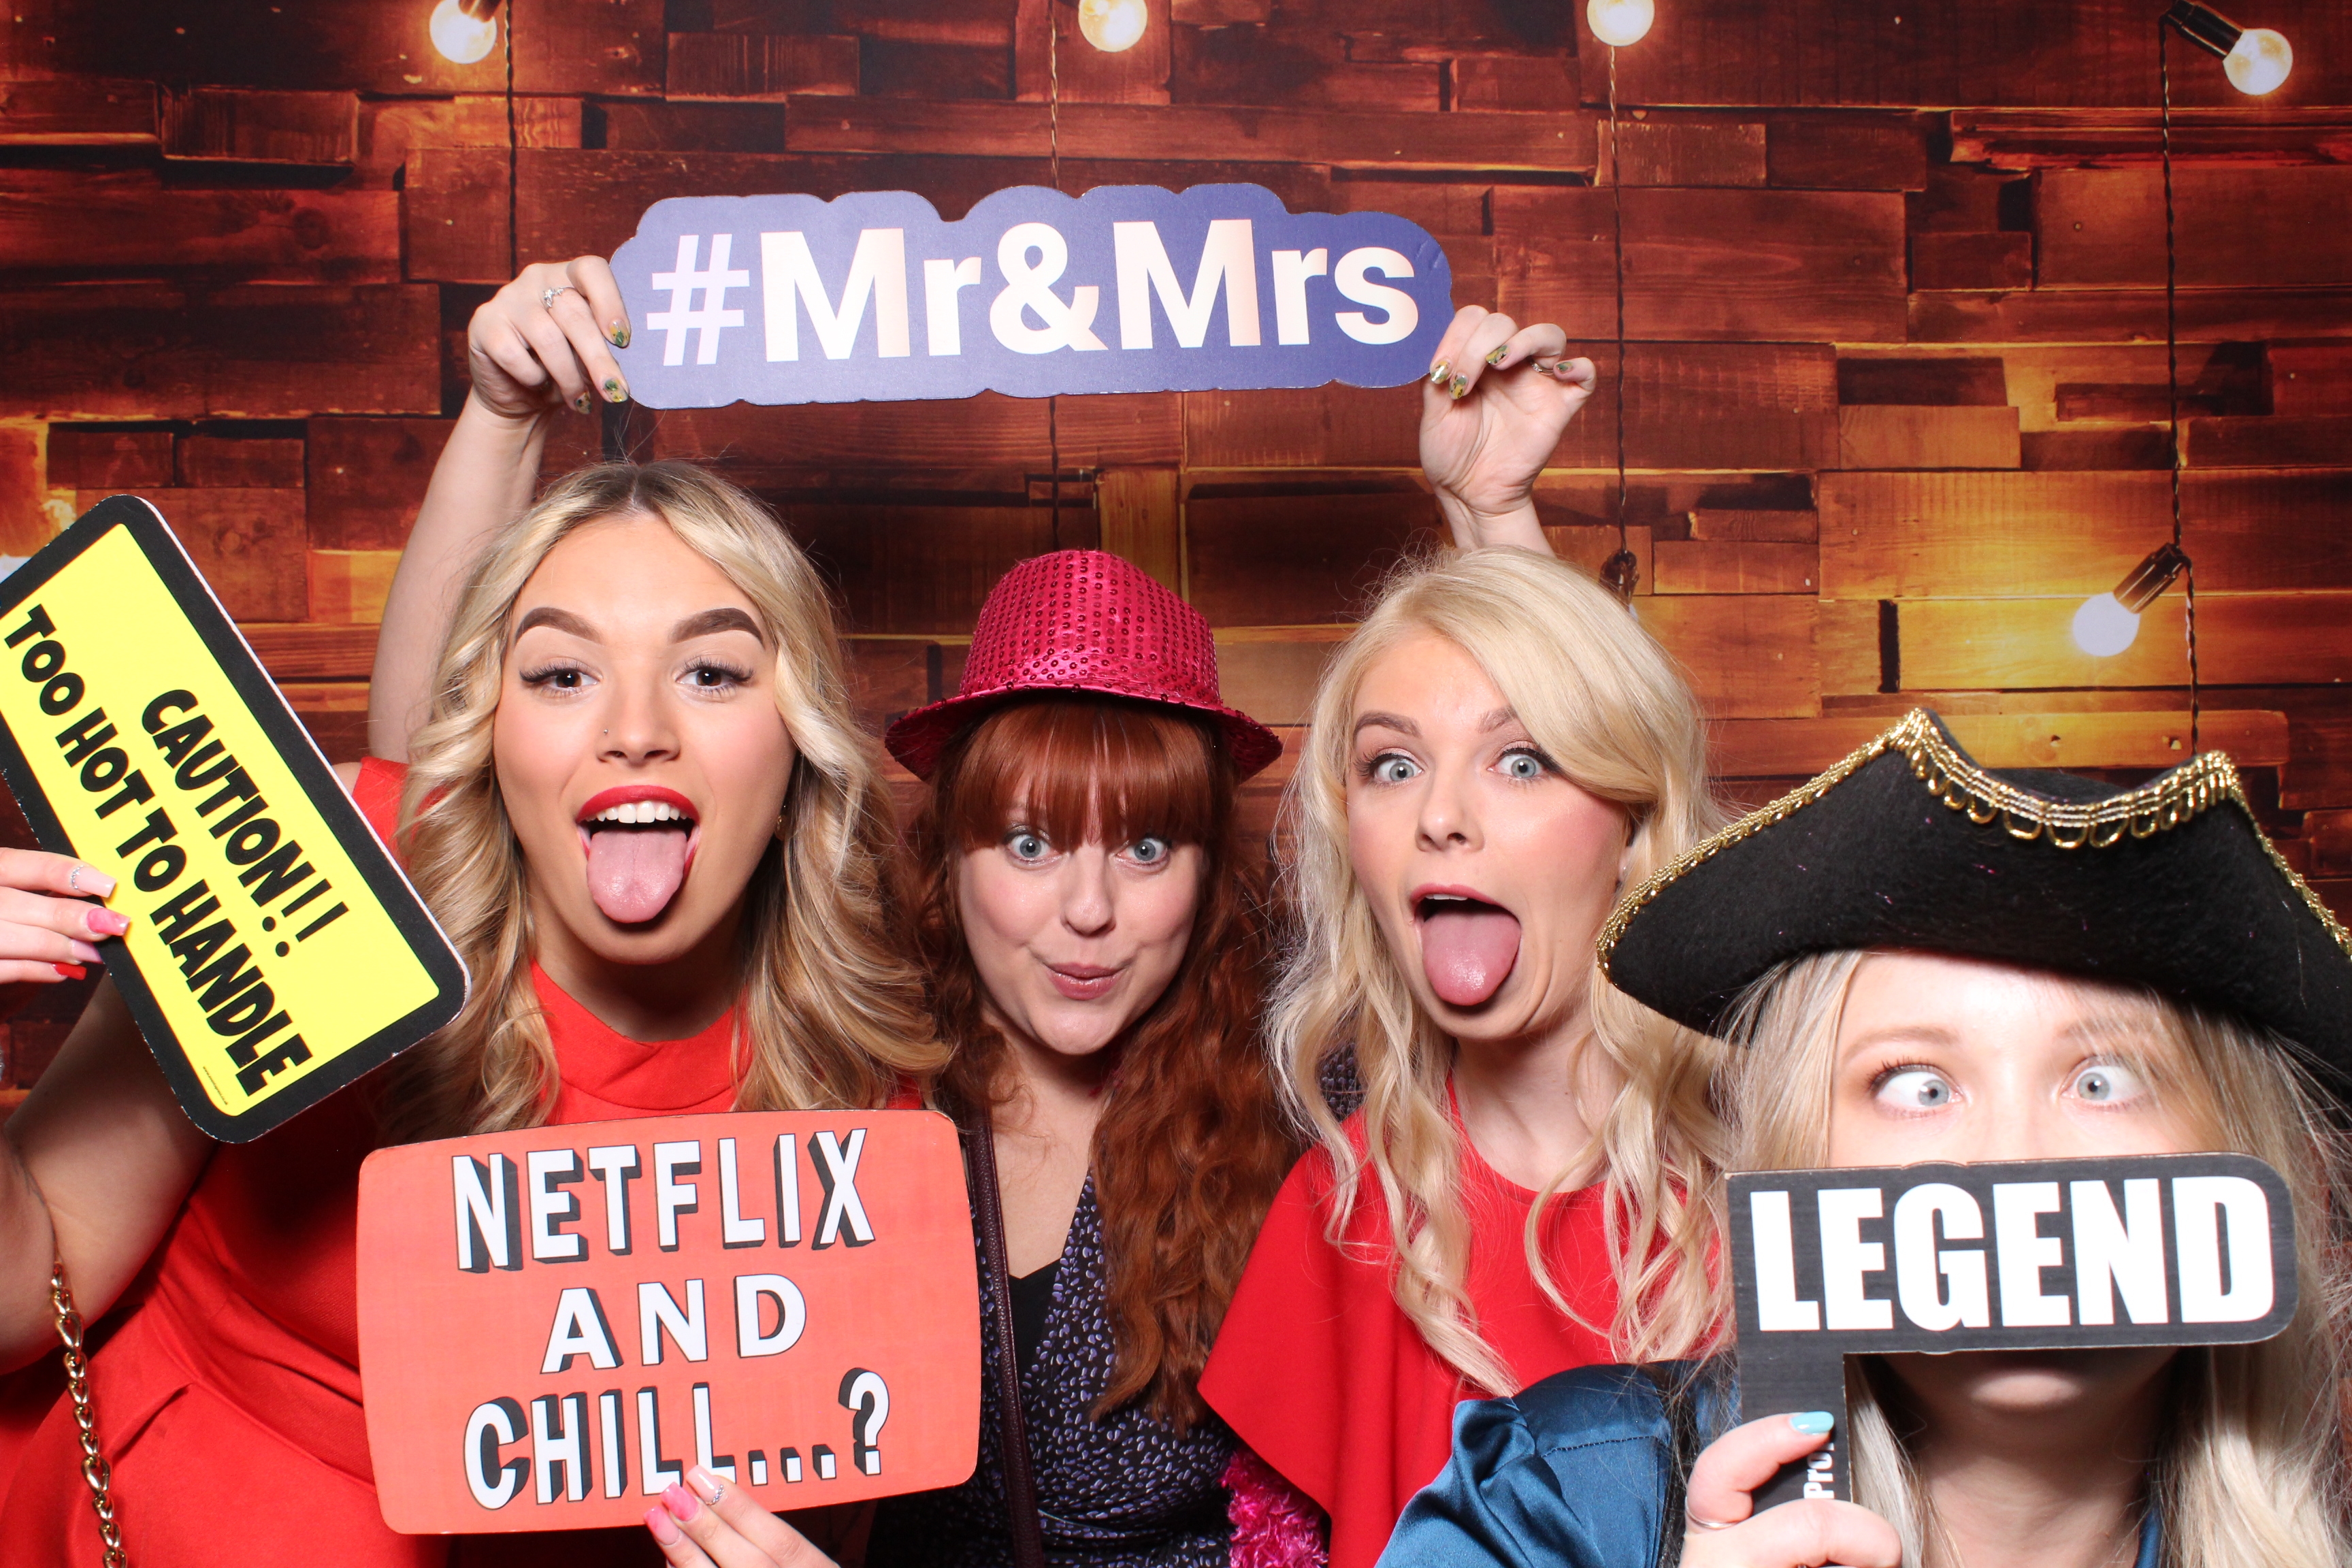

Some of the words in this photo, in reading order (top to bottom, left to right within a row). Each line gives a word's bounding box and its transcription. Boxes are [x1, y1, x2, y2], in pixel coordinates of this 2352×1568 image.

[646, 219, 1420, 367] #Mr&Mrs
[3, 604, 85, 716] TOO
[55, 707, 154, 819] HOT
[141, 689, 349, 958] CAUTION!!
[115, 806, 187, 893] TO
[149, 879, 314, 1097] HANDLE
[451, 1128, 876, 1274] NETFLIX
[1750, 1176, 2275, 1332] LEGEND
[540, 1273, 807, 1374] AND
